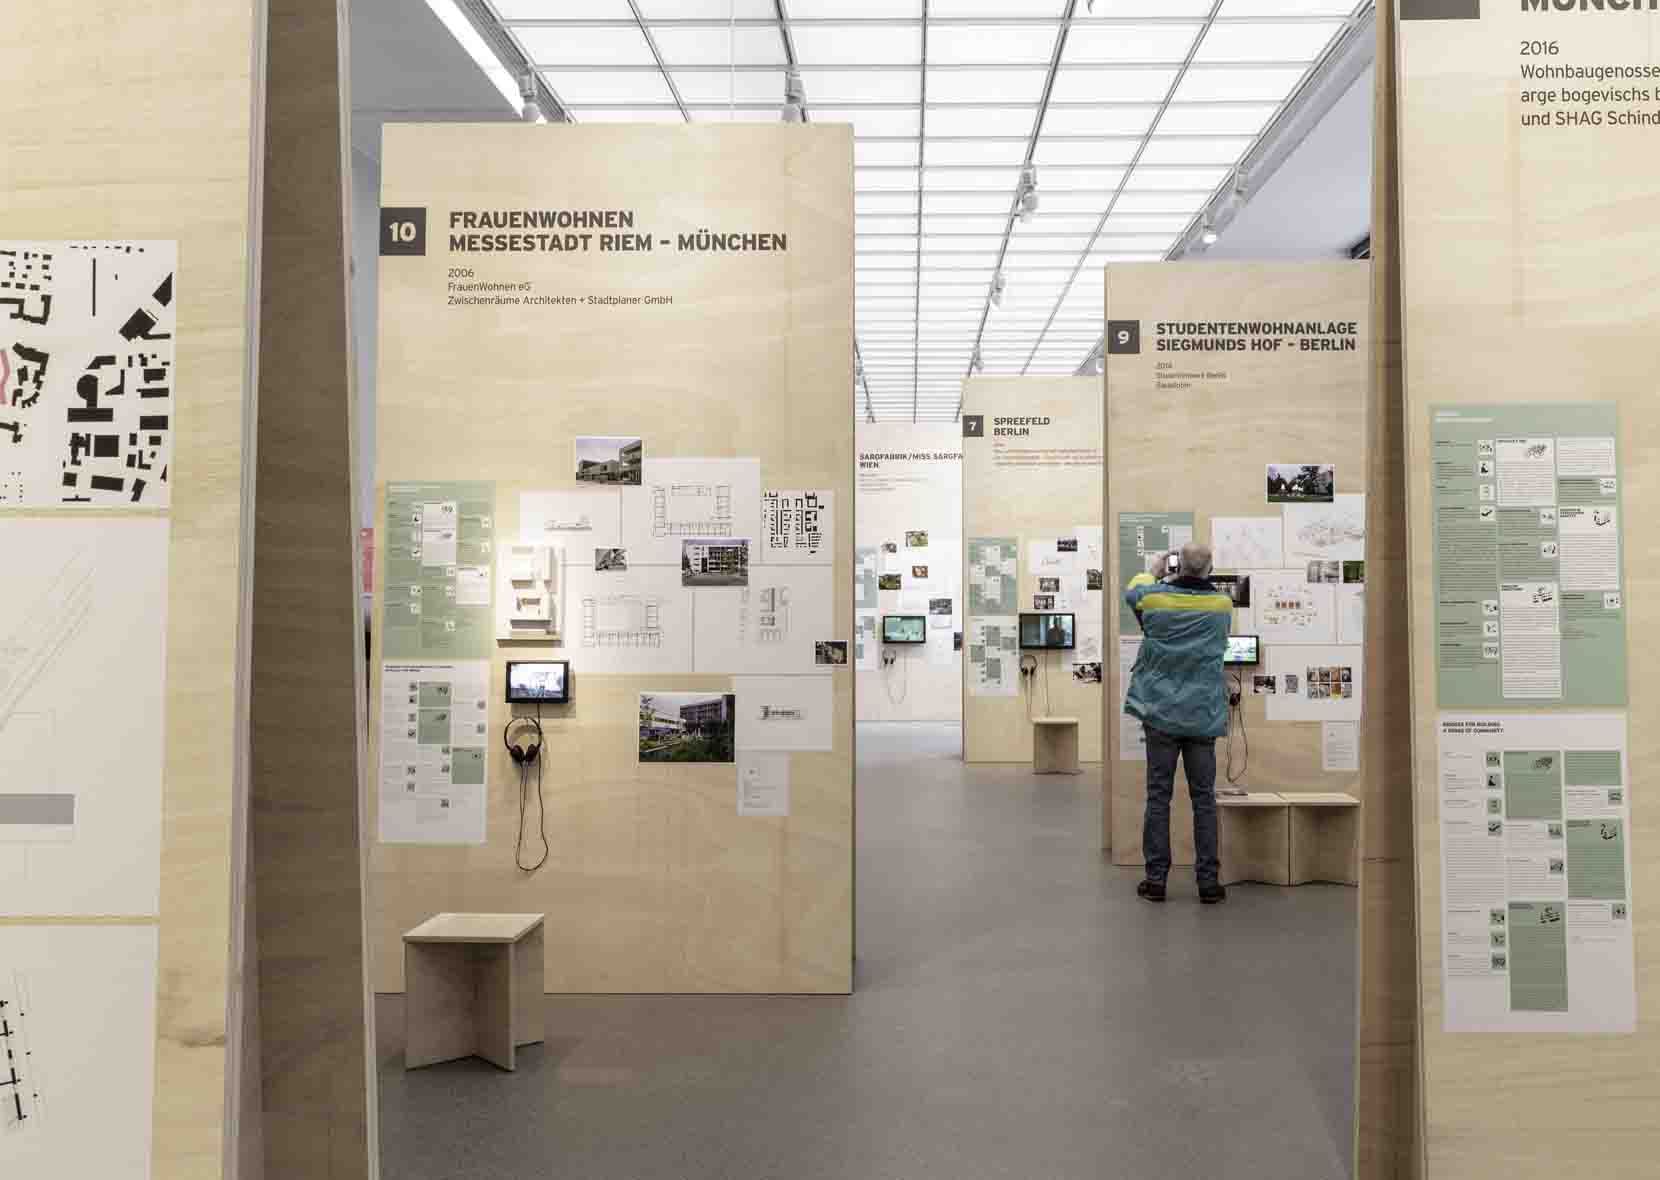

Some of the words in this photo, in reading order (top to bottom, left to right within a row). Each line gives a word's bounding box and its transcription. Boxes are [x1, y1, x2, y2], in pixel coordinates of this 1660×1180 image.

[1520, 41, 1559, 55] 2016
[1521, 64, 1660, 81] Wohnbaugenosse
[1521, 90, 1557, 105] arge
[1562, 87, 1650, 105] bogevischs
[1521, 112, 1550, 126] und
[1555, 111, 1602, 125] SHAG
[1607, 110, 1660, 125] Schind
[450, 211, 633, 228] FRAUENWOHNEN
[389, 222, 416, 242] 10
[450, 234, 592, 251] MESSESTADT
[600, 234, 652, 251] RIEM
[678, 229, 787, 251] MÜNCHEN
[448, 268, 474, 278] 2006
[448, 282, 516, 291] FrauenWohnen
[448, 296, 520, 305] Zwischenräume
[523, 296, 576, 305] Architekten
[588, 296, 640, 307] Stadtplaner
[644, 296, 672, 304] GmbH
[1157, 322, 1357, 335] STUDENTENWOHNANLAGE
[1118, 330, 1129, 344] 9
[1157, 339, 1246, 351] SIEGMUNDS
[1251, 339, 1282, 351] HOF
[1300, 339, 1356, 351] BERLIN
[968, 421, 977, 431] 7
[994, 417, 1050, 425] SPREEFELD
[994, 427, 1029, 436] BERLIN
[860, 461, 879, 469] WIEN
